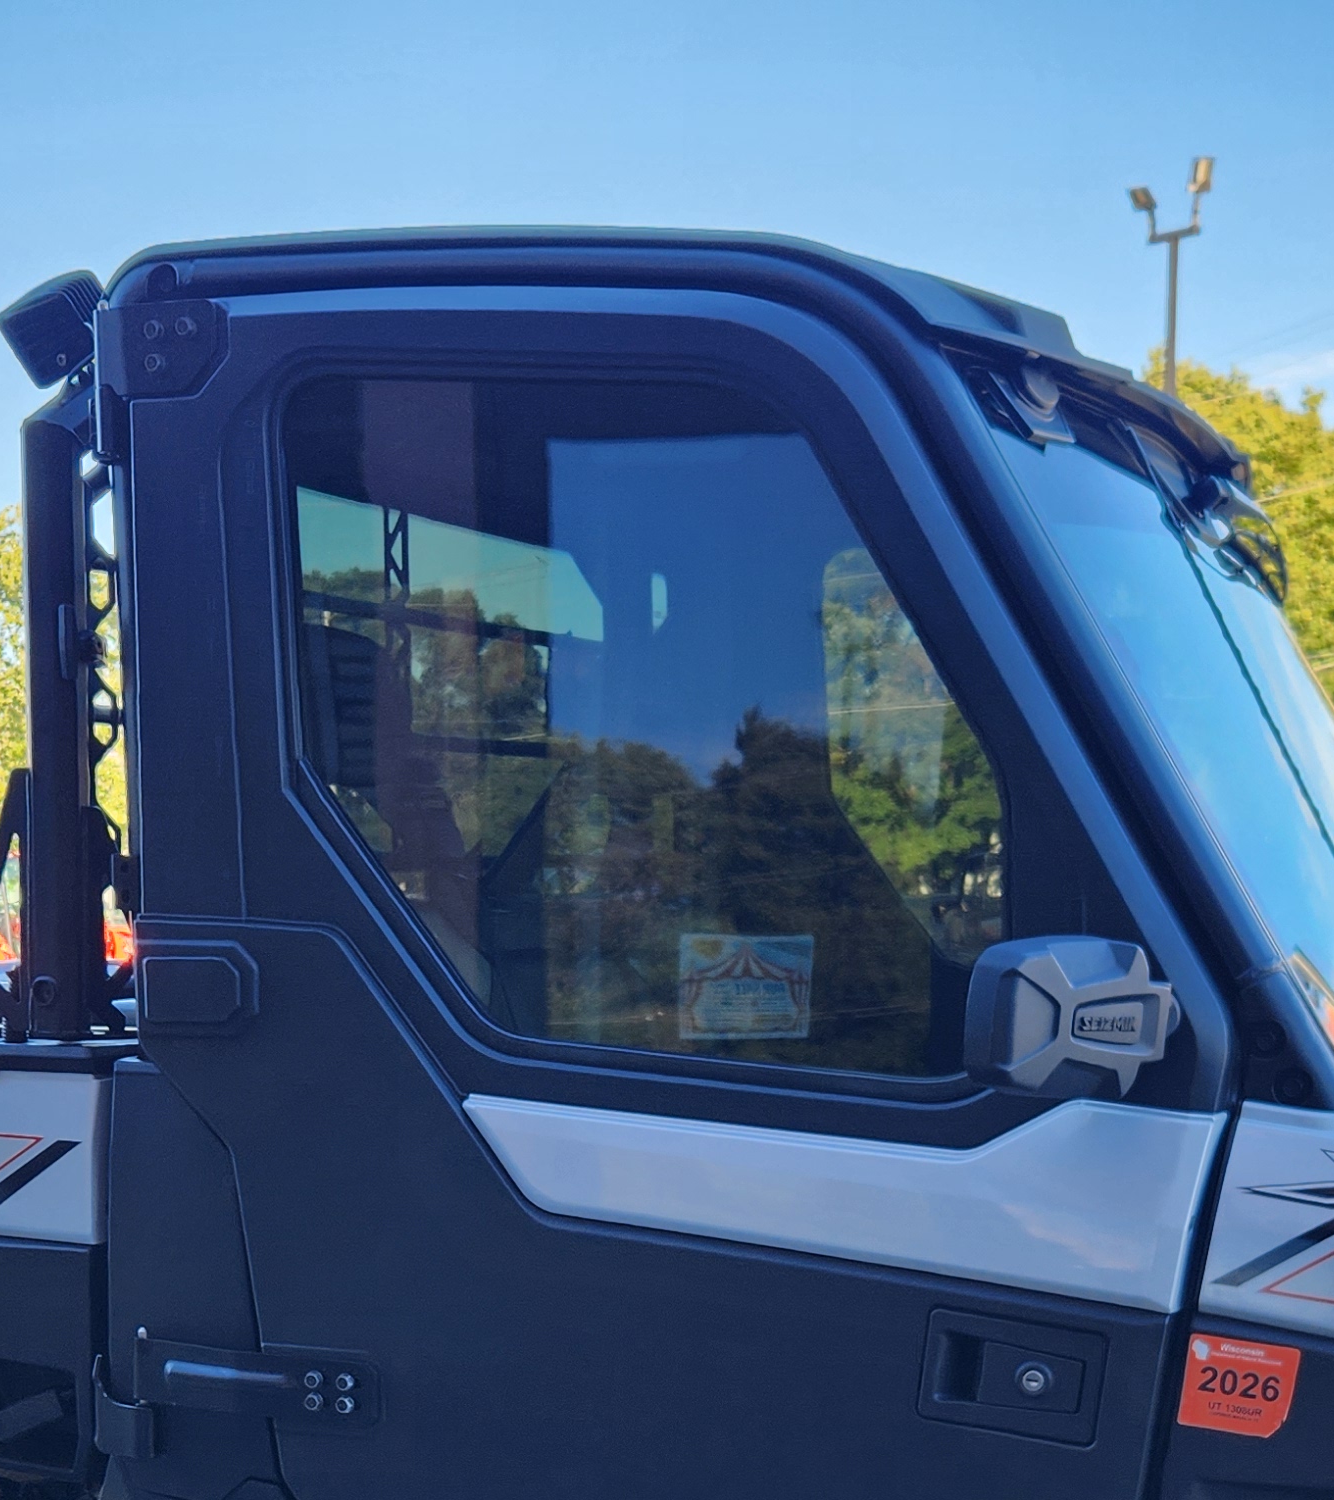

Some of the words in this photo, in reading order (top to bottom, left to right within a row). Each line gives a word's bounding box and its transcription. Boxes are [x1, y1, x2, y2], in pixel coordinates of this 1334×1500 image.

[1078, 1015, 1138, 1033] SEIZMIK
[1219, 1343, 1265, 1357] Wisconsin
[1197, 1365, 1281, 1402] 2026
